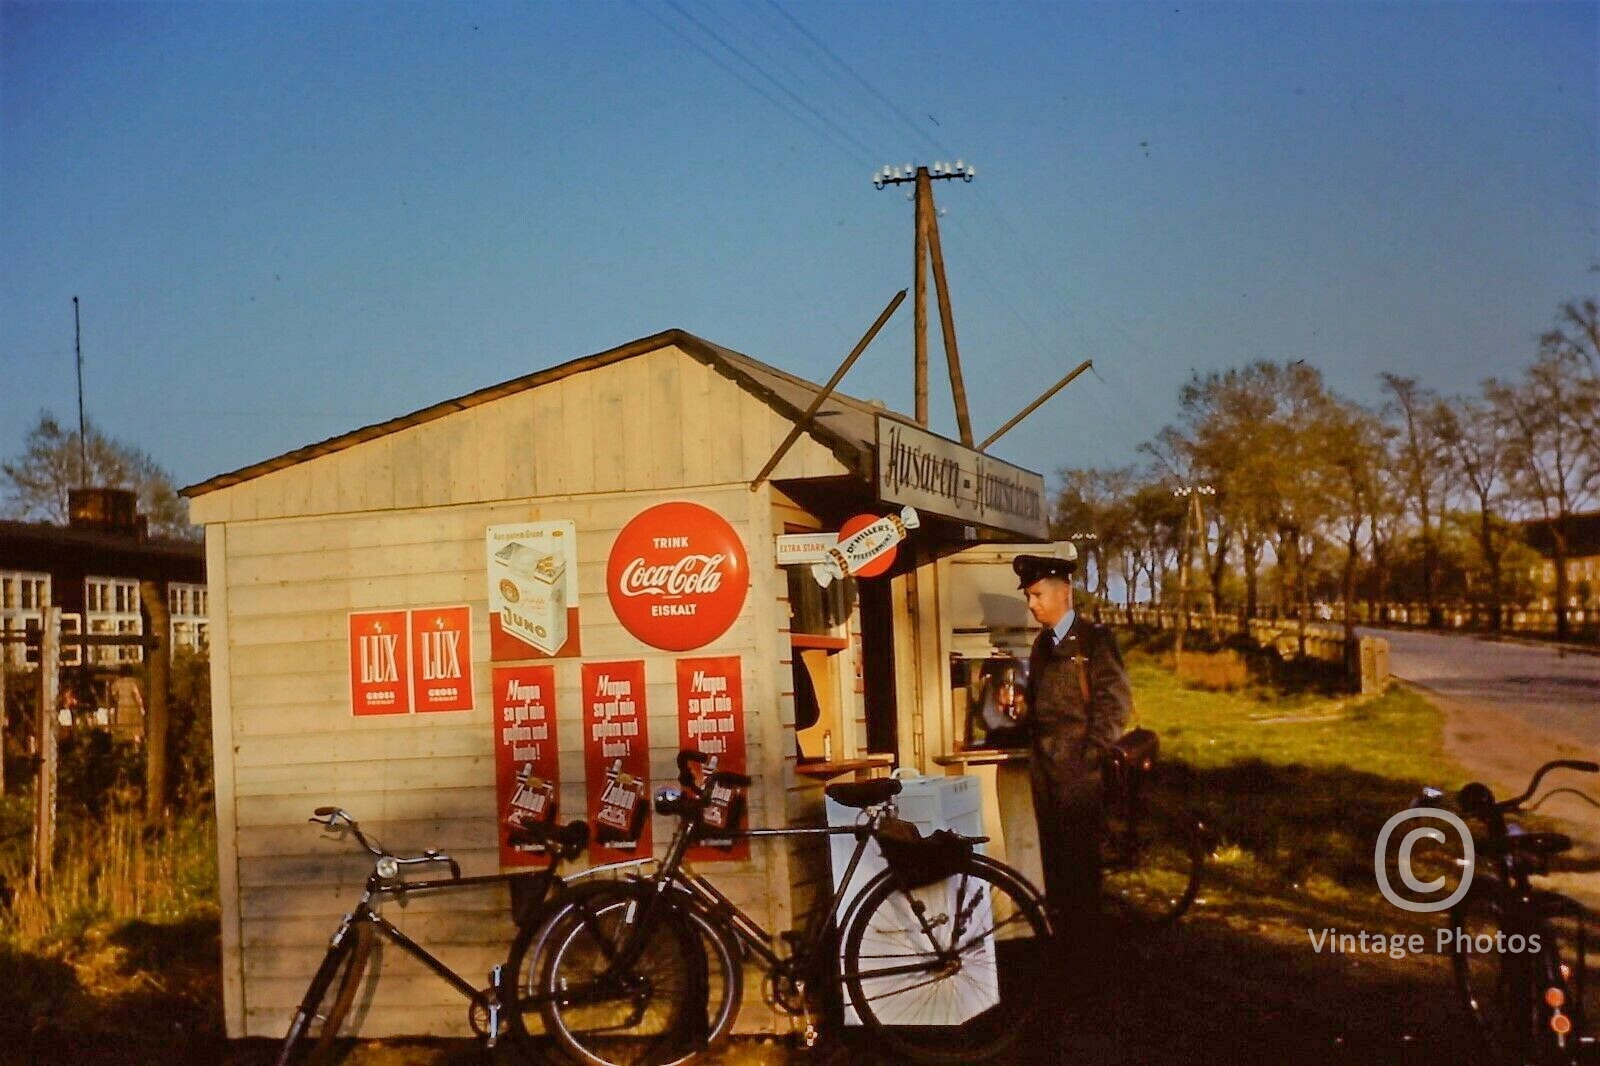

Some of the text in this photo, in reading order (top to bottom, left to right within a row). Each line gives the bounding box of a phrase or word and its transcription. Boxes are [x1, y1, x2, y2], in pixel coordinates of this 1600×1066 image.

[652, 537, 689, 549] TRINK
[780, 542, 825, 553] EXTRA STARK
[620, 554, 726, 597] Coca-Cola
[651, 604, 697, 617] EISKALT
[360, 634, 399, 684] LUX
[421, 630, 462, 680] LUX
[593, 702, 604, 717] so
[688, 698, 700, 714] so
[503, 707, 514, 721] so
